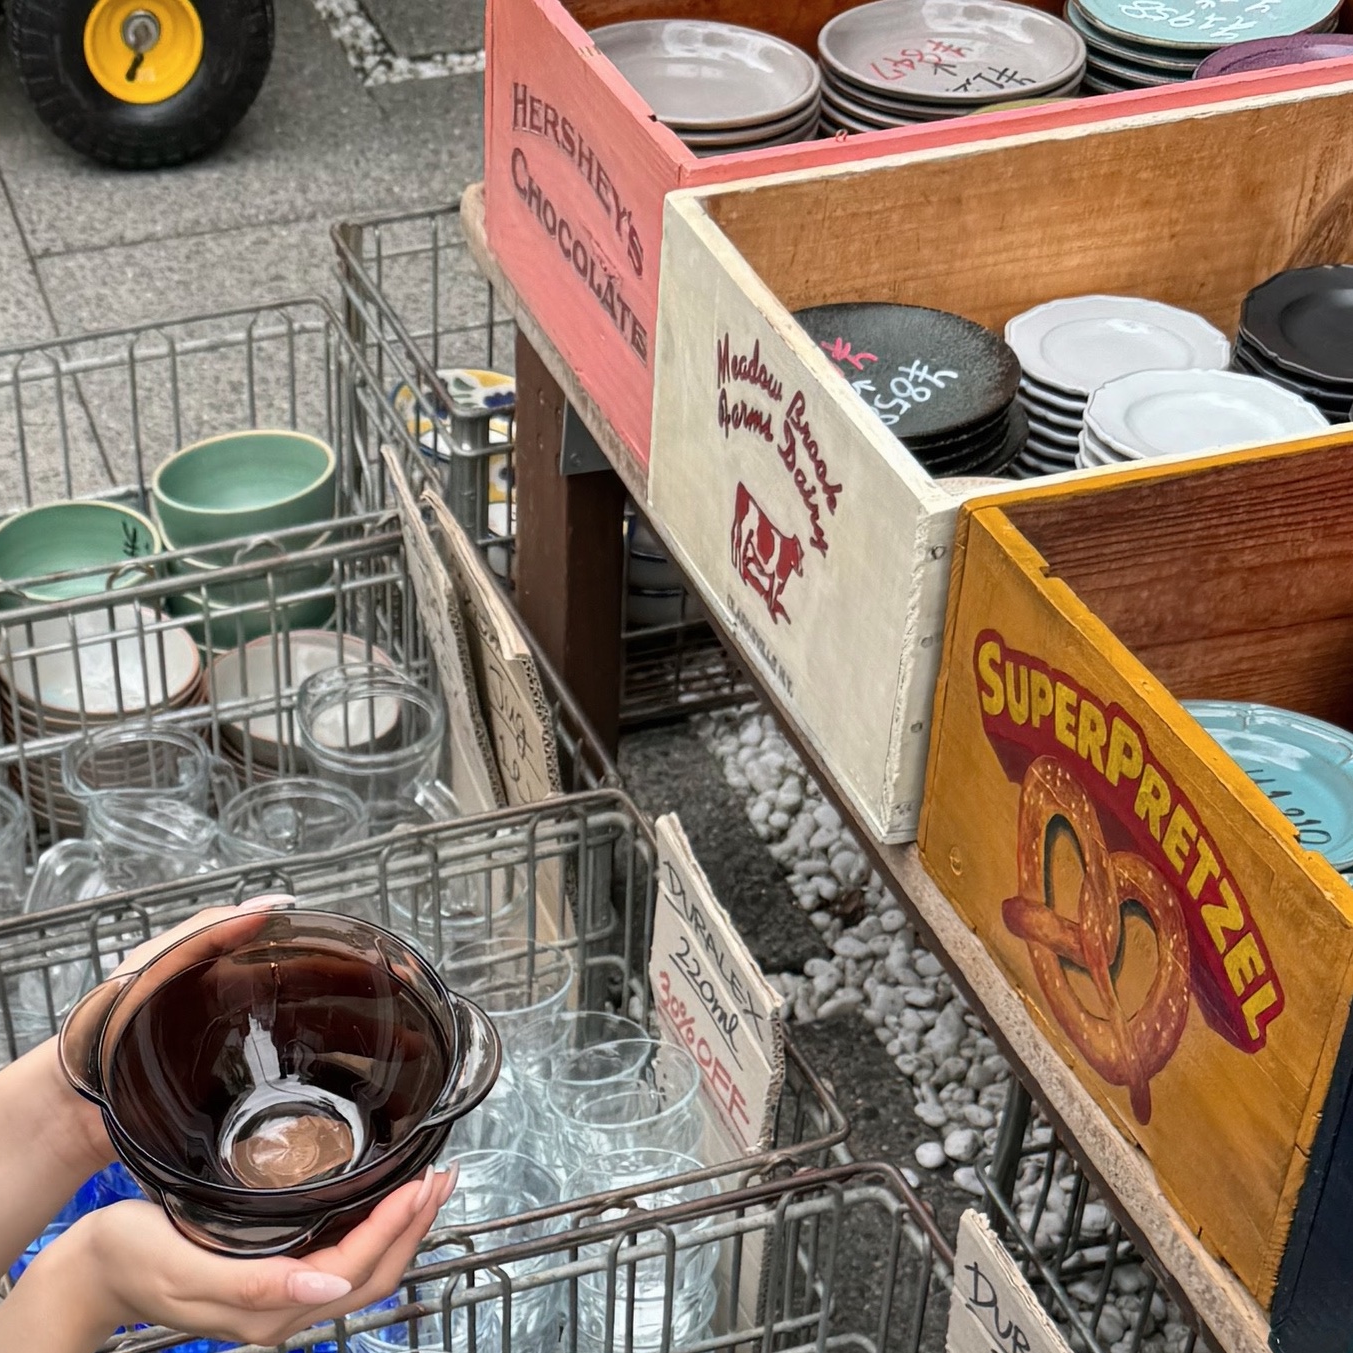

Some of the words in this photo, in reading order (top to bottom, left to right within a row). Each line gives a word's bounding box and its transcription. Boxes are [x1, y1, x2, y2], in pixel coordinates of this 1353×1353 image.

[513, 82, 644, 279] HERSHEY'S
[777, 419, 828, 558] Dairy
[786, 390, 843, 516] Brook
[978, 640, 1279, 1041] SUPERPRETZEL
[663, 861, 764, 1042] DURALEX
[675, 936, 739, 1053] 220ml
